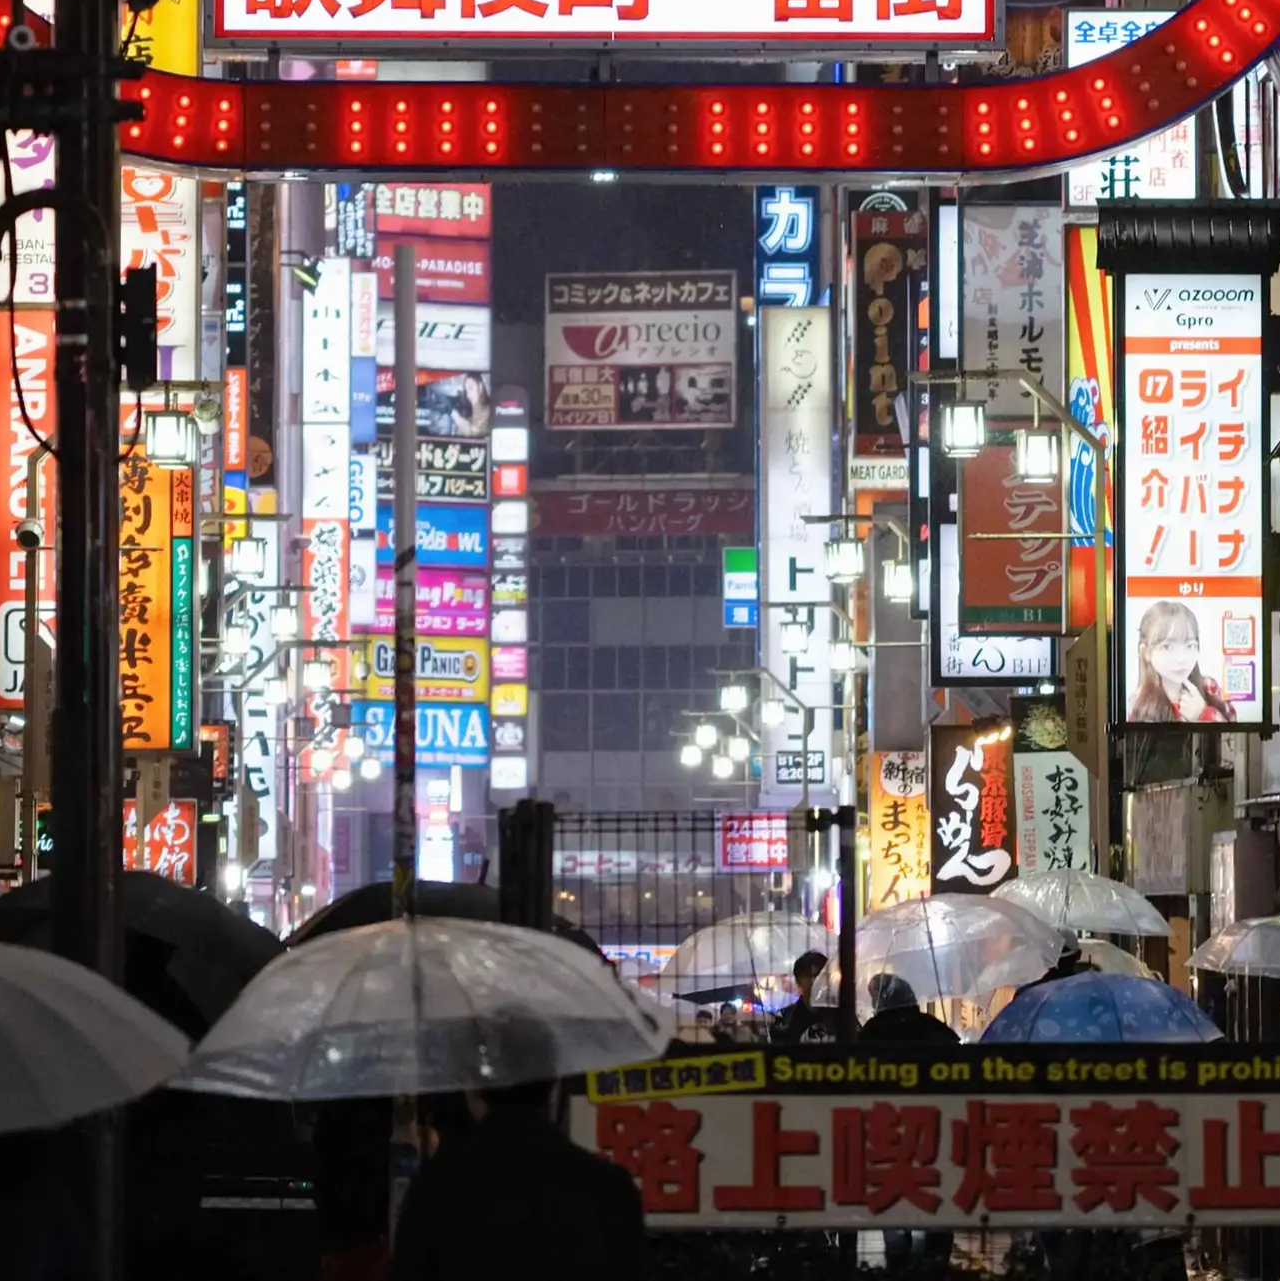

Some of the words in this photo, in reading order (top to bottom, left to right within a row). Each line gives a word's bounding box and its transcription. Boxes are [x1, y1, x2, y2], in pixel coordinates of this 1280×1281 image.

[1074, 185, 1094, 201] 3F
[553, 282, 730, 305] コミック&ネットカフェ
[1178, 287, 1255, 303] azooom
[1176, 314, 1214, 330] Gpro
[1170, 338, 1220, 353] presents
[851, 466, 876, 480] MEAT
[878, 466, 910, 481] GARD
[1178, 370, 1211, 568] ライバー
[1217, 368, 1247, 570] イチナナ
[1178, 581, 1204, 597] ゆり
[1022, 607, 1043, 623] B1
[1012, 657, 1048, 673] B1F
[772, 1055, 918, 1087] Smoking
[930, 1059, 970, 1082] on
[982, 1056, 1035, 1082] the
[1046, 1057, 1147, 1082] street
[1159, 1056, 1187, 1081] is
